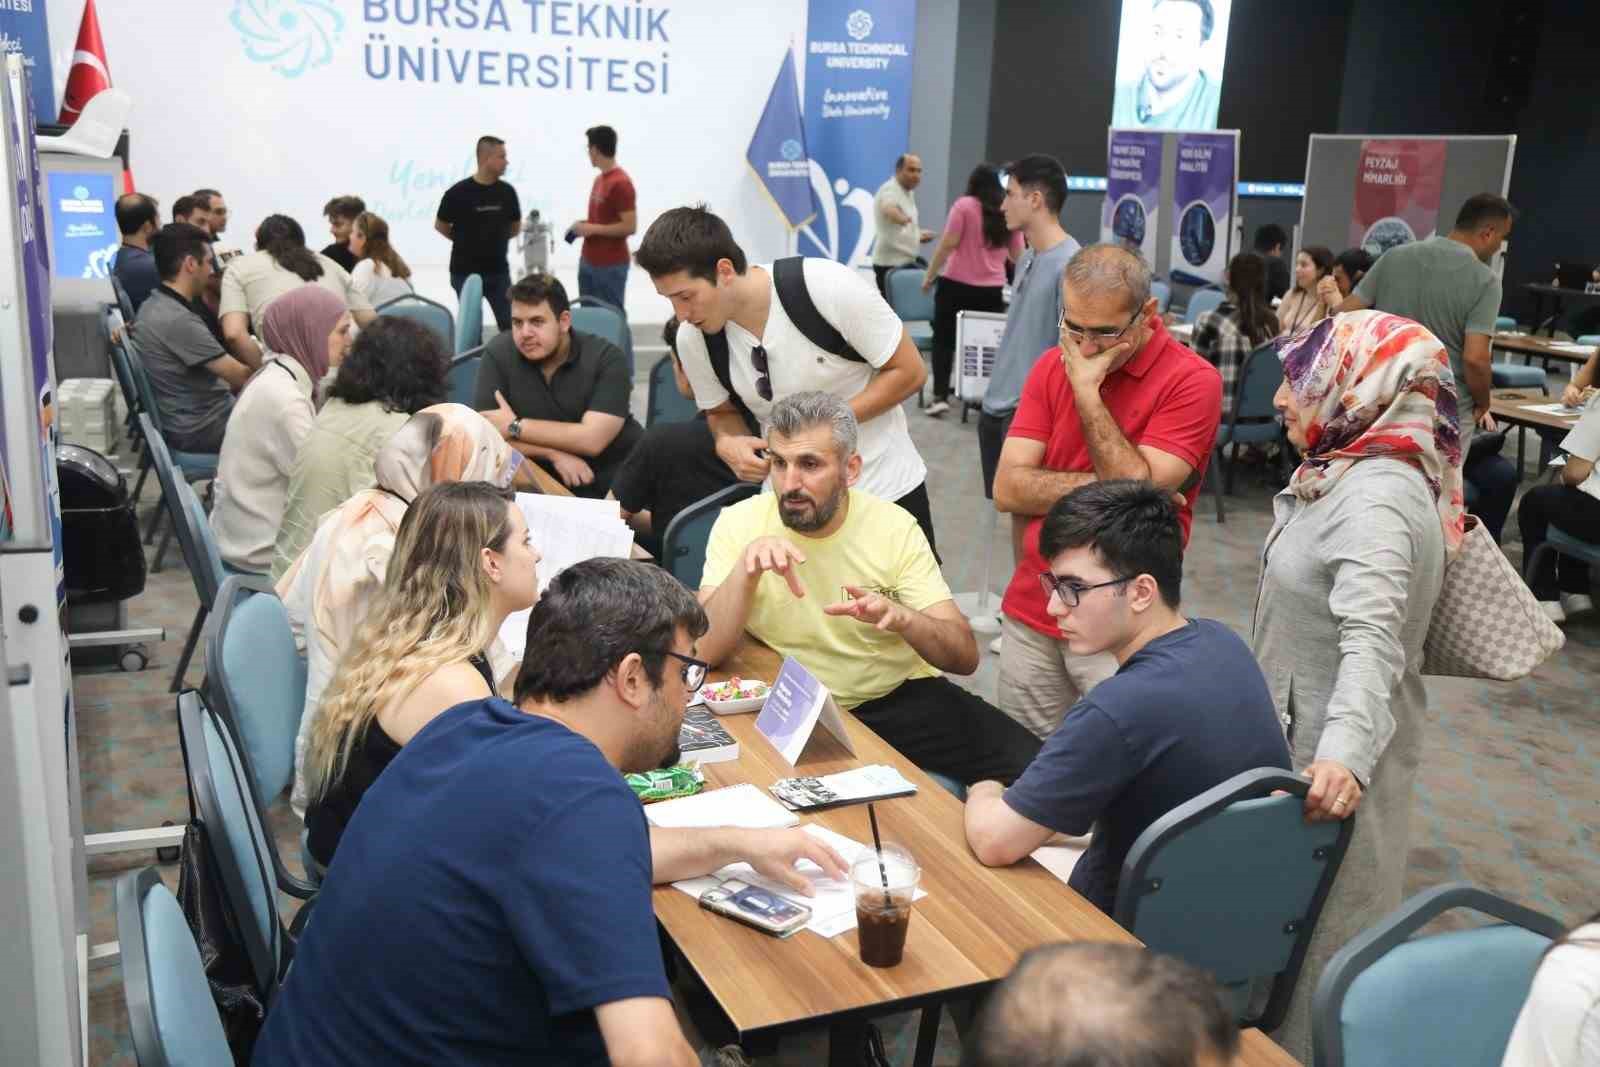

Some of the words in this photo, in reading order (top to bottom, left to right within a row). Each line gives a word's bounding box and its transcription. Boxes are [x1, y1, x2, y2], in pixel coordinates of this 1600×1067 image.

[363, 0, 511, 32] BURSA
[522, 0, 671, 42] TEKNİK
[809, 41, 847, 54] BURSA
[848, 42, 909, 56] TECHNICAL
[364, 33, 670, 94] ÜNİVERSİTESİ
[826, 56, 890, 70] UNIVERSITY
[1365, 156, 1399, 169] PEYZAJ
